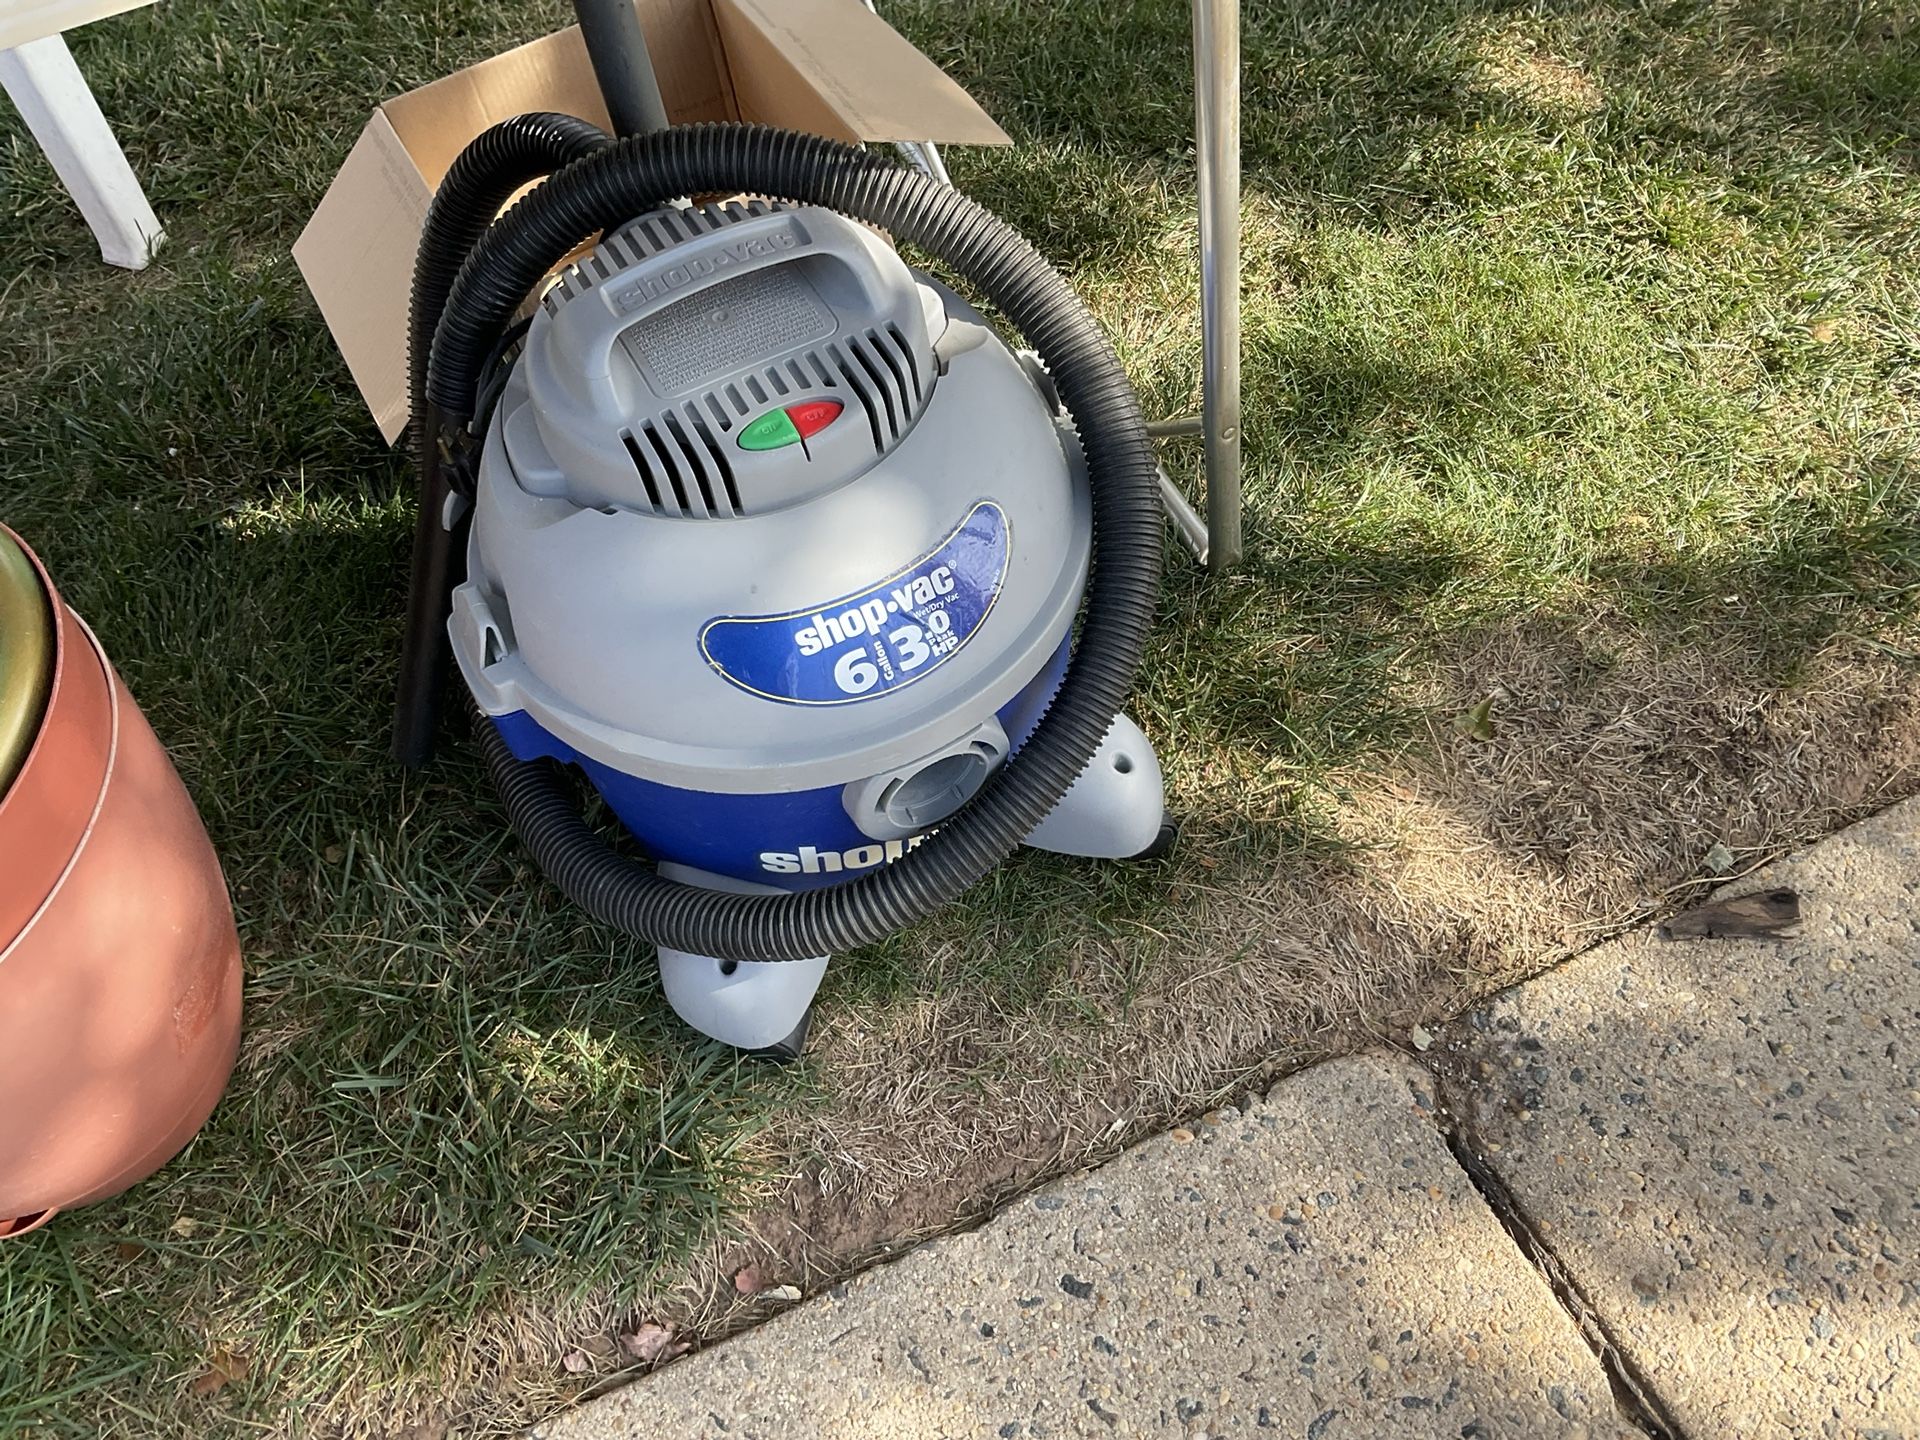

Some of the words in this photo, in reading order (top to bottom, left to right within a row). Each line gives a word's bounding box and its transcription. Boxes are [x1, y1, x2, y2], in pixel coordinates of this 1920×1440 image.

[914, 600, 945, 618] Wet/Dry
[944, 592, 961, 604] Vac
[834, 647, 879, 694] 6
[873, 640, 895, 681] Gallon
[931, 635, 959, 658] HP
